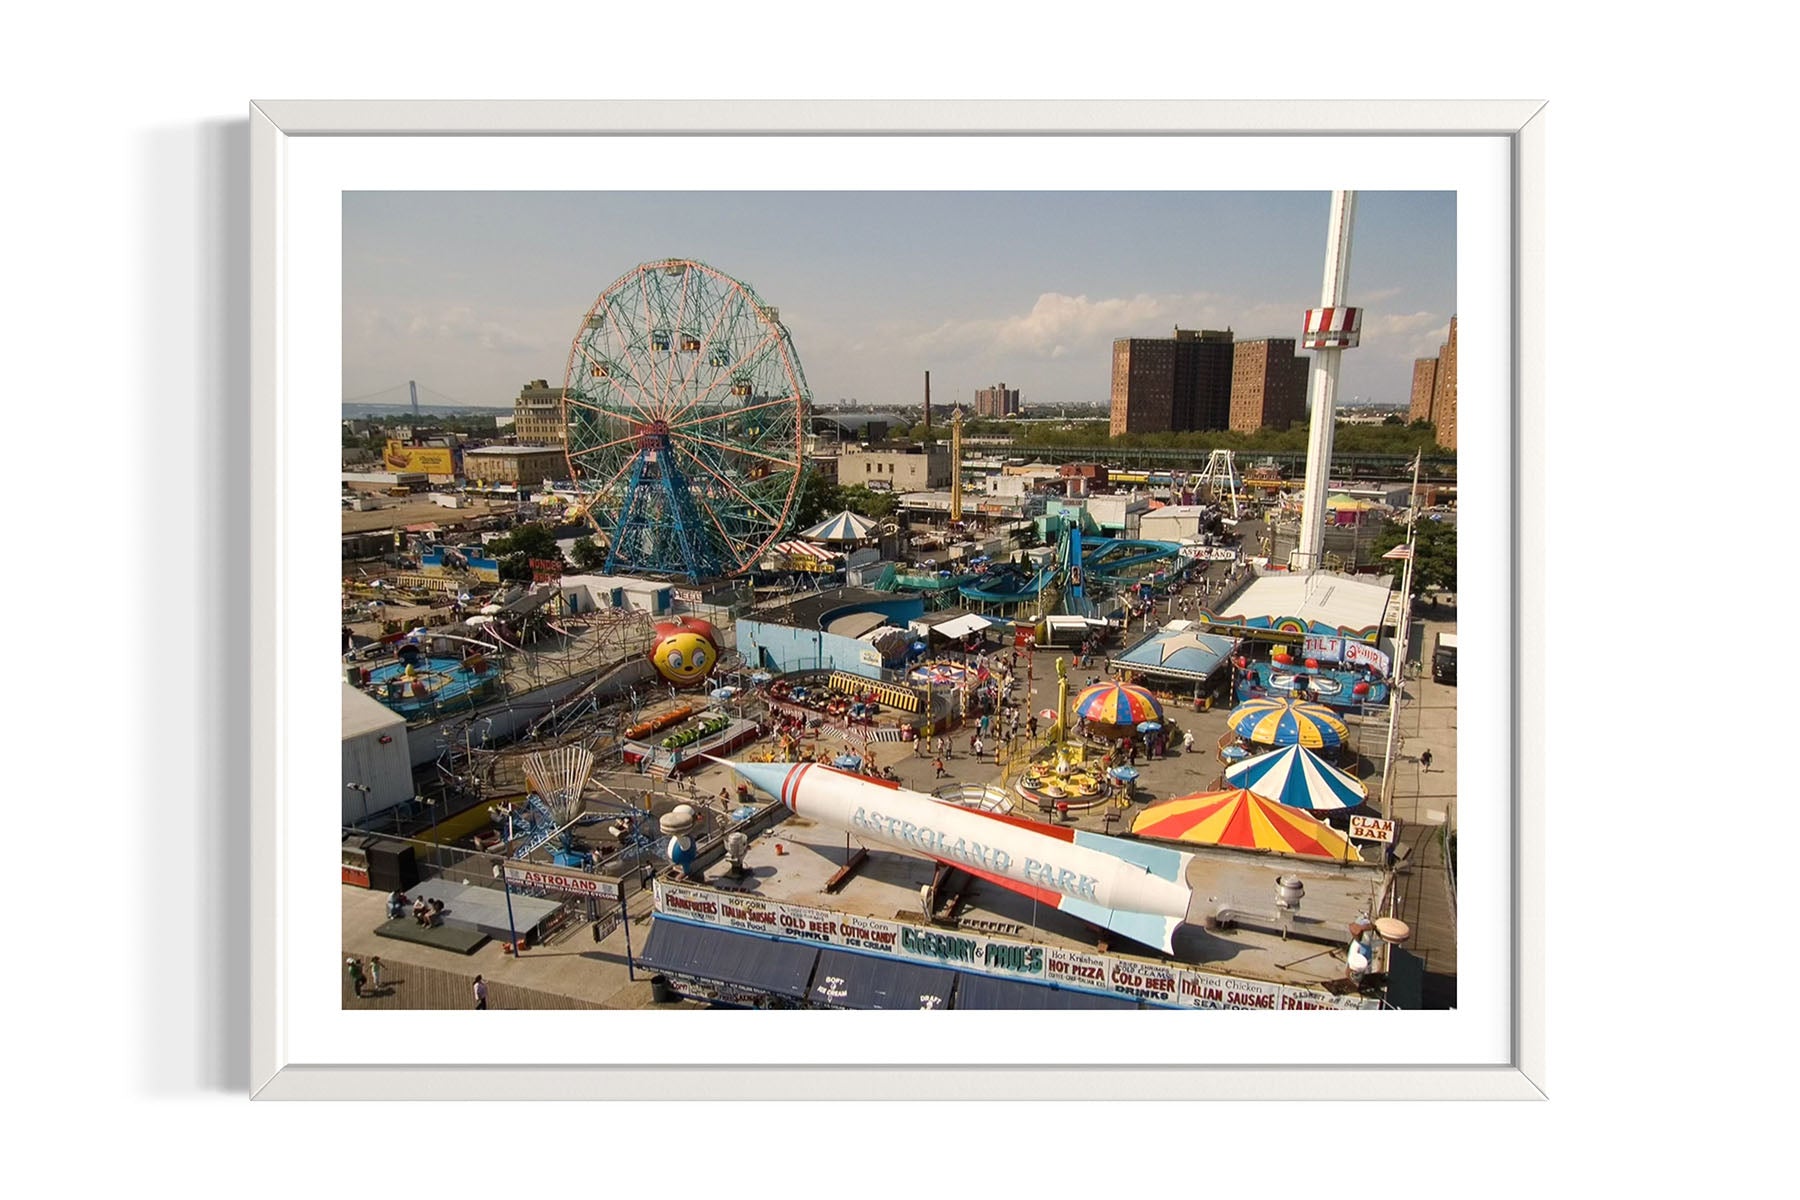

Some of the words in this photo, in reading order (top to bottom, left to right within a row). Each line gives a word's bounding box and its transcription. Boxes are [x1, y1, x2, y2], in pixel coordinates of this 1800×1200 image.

[1305, 639, 1337, 651] TILT
[1351, 816, 1392, 831] CLAM
[1354, 827, 1387, 840] BAR
[852, 807, 1013, 870] ASTROLAND
[1024, 857, 1100, 898] PARK
[525, 871, 597, 891] ASTROLAND
[729, 898, 744, 907] HOT
[721, 903, 747, 920] ITALIAN
[747, 908, 777, 926] SAUSAGE
[731, 919, 746, 928] Sea
[747, 922, 767, 932] Food
[780, 914, 806, 930] COLD
[809, 921, 837, 935] BEER
[852, 917, 868, 929] Pop
[869, 920, 889, 931] Corn
[786, 928, 830, 941] DRINKS
[840, 923, 870, 940] COTTON
[871, 930, 897, 945] CANDY
[846, 938, 861, 946] ICE
[863, 941, 892, 952] CREAM
[901, 926, 977, 963] GREGORY
[975, 947, 984, 958] &
[1052, 950, 1066, 960] Hot
[1049, 959, 1070, 973] HOT
[1072, 966, 1105, 981] PIZZA
[1111, 971, 1142, 986] COLD
[1146, 978, 1175, 993] BEER
[1194, 974, 1220, 987] Fried
[1225, 979, 1263, 993] Chicken
[1115, 985, 1169, 1000] DRINKS
[1182, 979, 1223, 1002] ITALIAN
[1227, 991, 1275, 1009] SAUSAGE
[1194, 999, 1217, 1009] SEA
